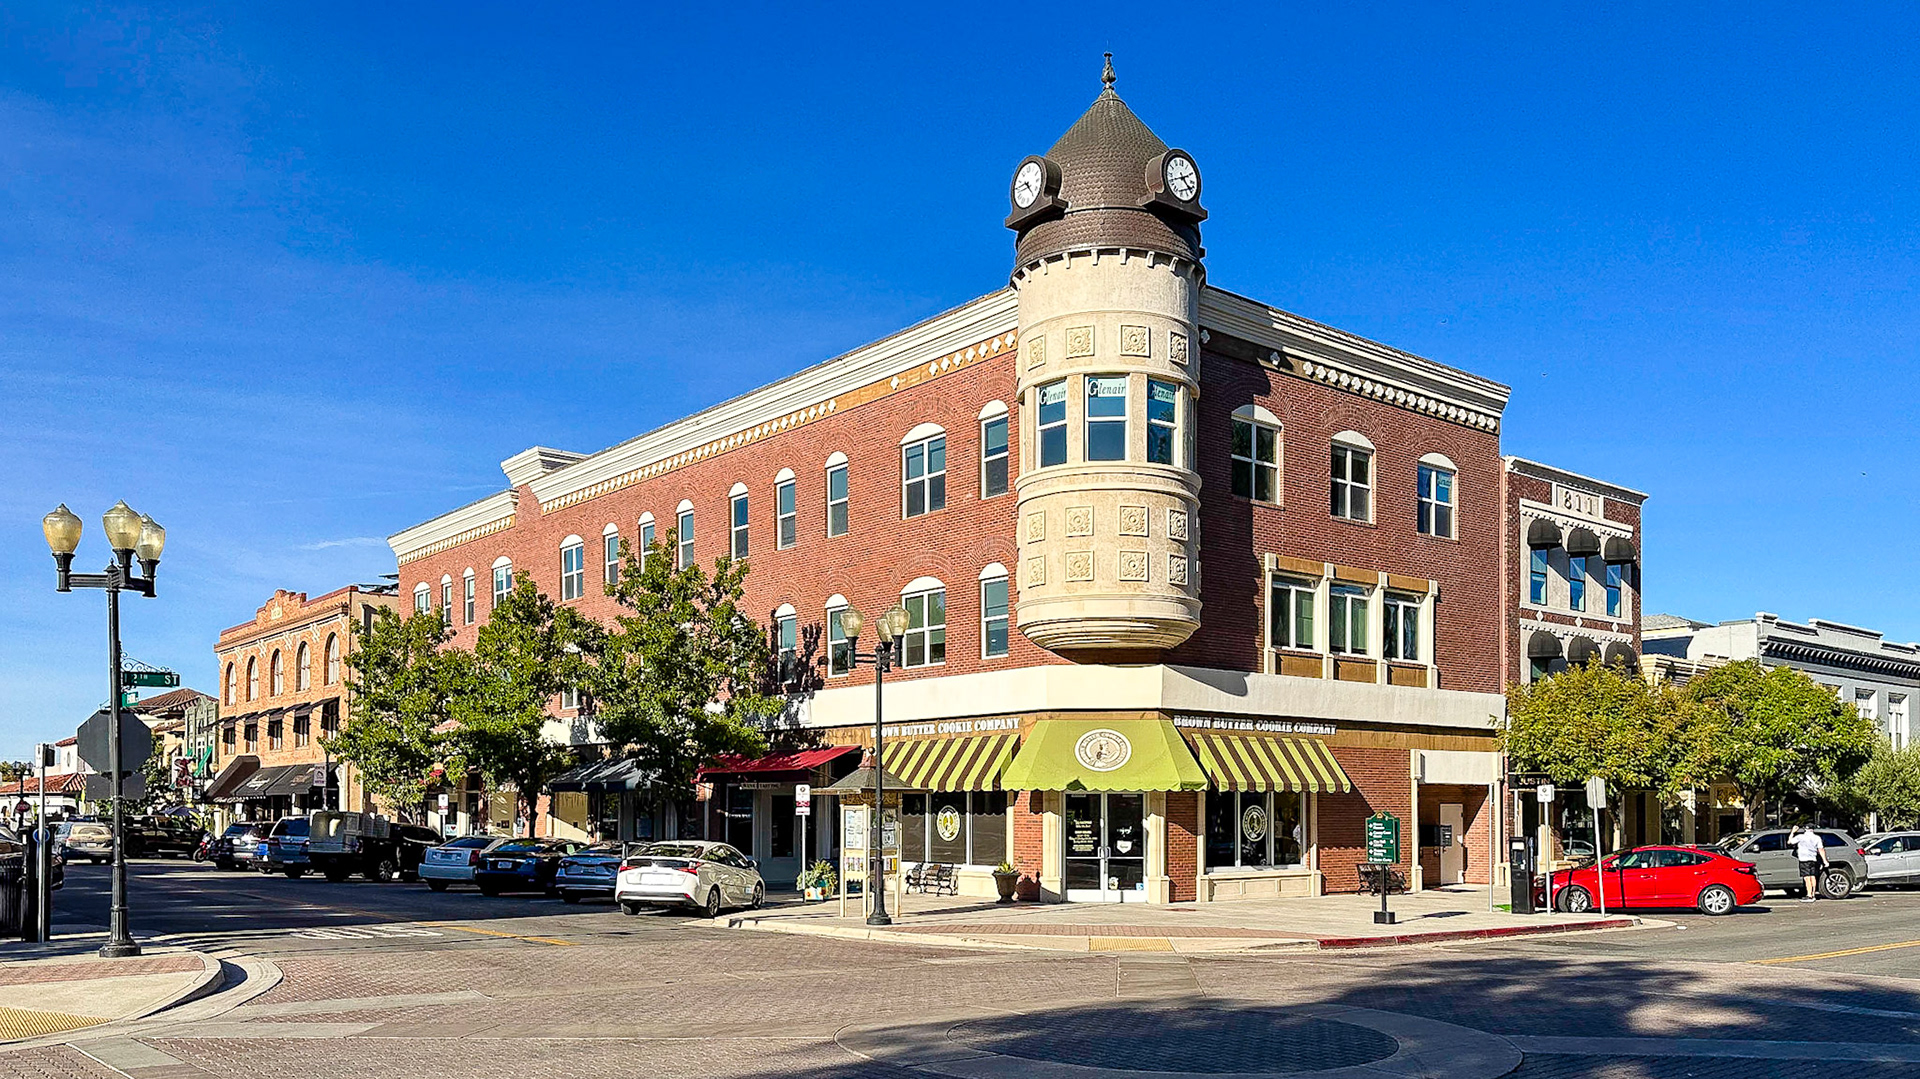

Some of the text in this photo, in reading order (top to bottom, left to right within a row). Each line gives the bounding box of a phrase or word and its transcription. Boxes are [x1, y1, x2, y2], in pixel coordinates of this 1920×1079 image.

[1088, 380, 1126, 397] Glenair
[1564, 490, 1594, 516] 811
[164, 674, 179, 685] ST
[870, 717, 1020, 738] BOWN BUTTER COOKIE COMPANY
[1173, 715, 1337, 735] BROWN BUTTER COOKIE COMPANY
